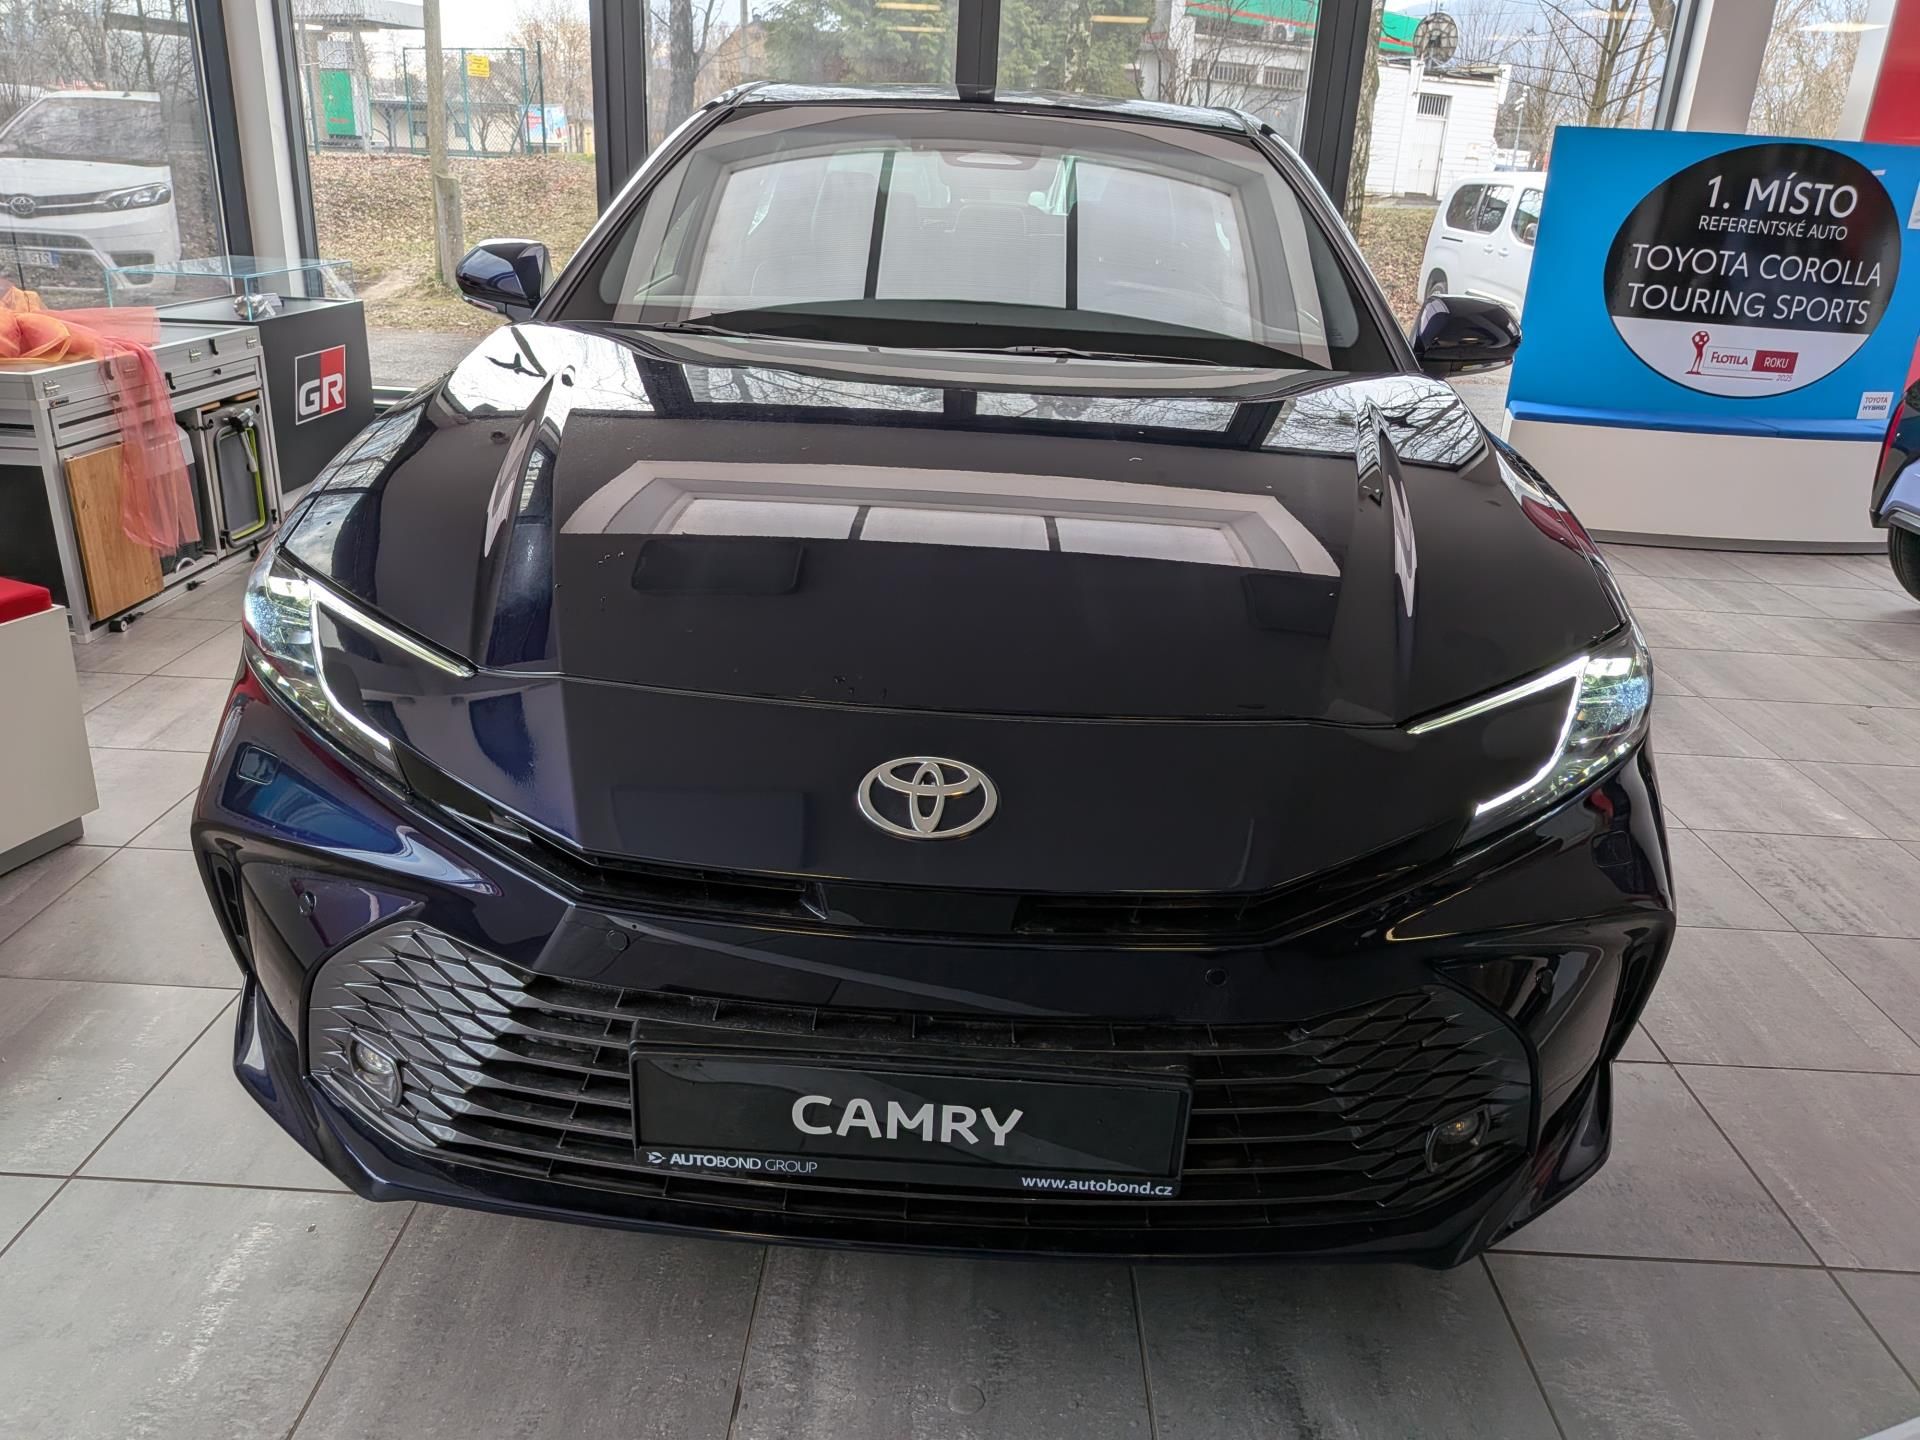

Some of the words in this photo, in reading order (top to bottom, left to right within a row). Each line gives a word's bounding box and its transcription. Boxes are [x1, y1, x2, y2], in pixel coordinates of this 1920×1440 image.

[1707, 175, 1730, 209] 1.
[1744, 172, 1858, 219] MÍSTO
[1698, 215, 1806, 238] REFERENTSKÉ
[1806, 223, 1848, 241] AUTO
[1632, 243, 1749, 278] TOYOTA
[1759, 254, 1881, 287] COROLLA
[1628, 282, 1766, 318] TOURING
[1773, 294, 1870, 325] SPORTS
[1710, 351, 1749, 366] FLOTILA
[1763, 356, 1790, 369] ROKU
[299, 373, 343, 416] GR
[1865, 396, 1888, 404] TOYOTA
[791, 1094, 1024, 1147] CAMRY
[670, 1153, 762, 1170] AUTOBOND
[765, 1158, 818, 1174] GROUP
[1021, 1174, 1174, 1197] www.autobond.cz
